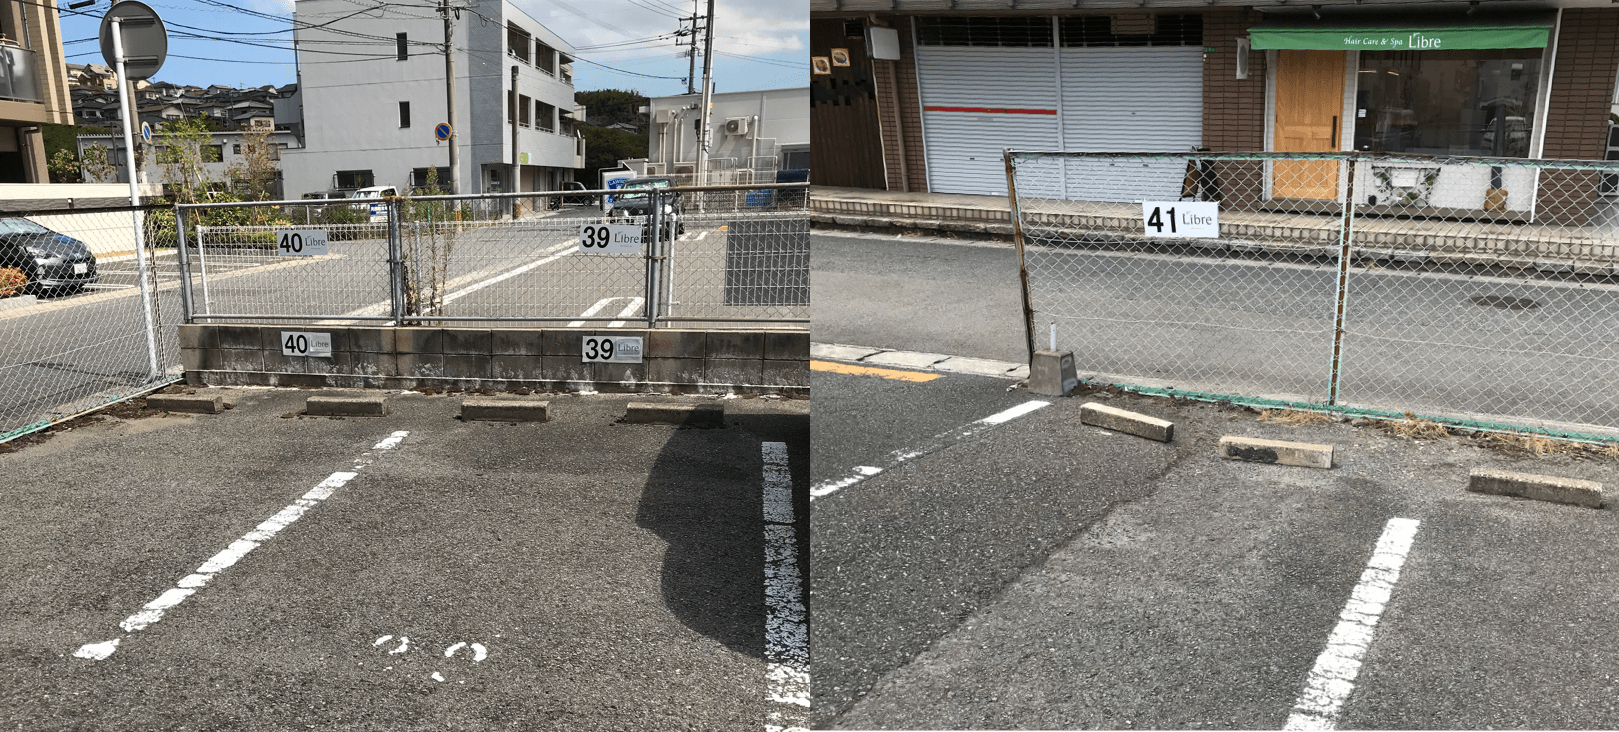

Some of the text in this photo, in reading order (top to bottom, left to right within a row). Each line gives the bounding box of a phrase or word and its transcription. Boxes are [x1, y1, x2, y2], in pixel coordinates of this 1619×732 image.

[1343, 32, 1442, 49] Hair Care & Spa Libre
[1147, 206, 1212, 234] 41 Libre
[279, 232, 326, 253] 40 Libre
[582, 226, 639, 248] 39 Libre
[284, 334, 329, 354] 40 Libre
[585, 338, 640, 360] 39 Libre
